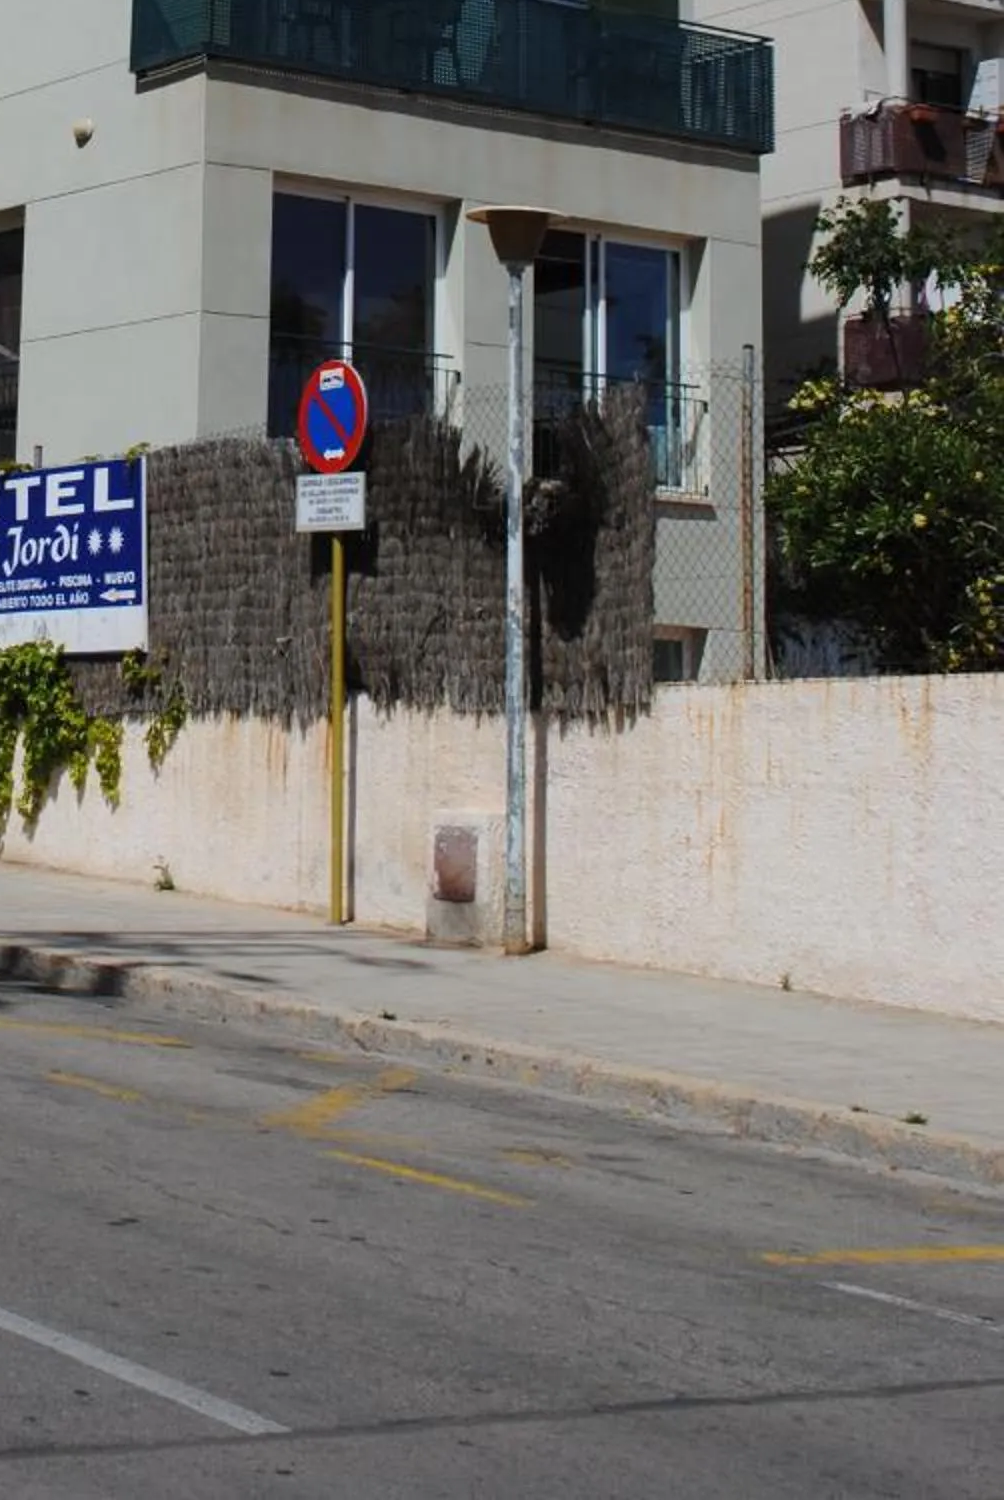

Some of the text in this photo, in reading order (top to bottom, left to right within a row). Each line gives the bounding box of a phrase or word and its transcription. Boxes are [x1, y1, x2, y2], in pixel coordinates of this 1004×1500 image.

[2, 521, 80, 577] Jordi
[104, 571, 136, 585] NUEVO
[56, 593, 67, 605] EL
